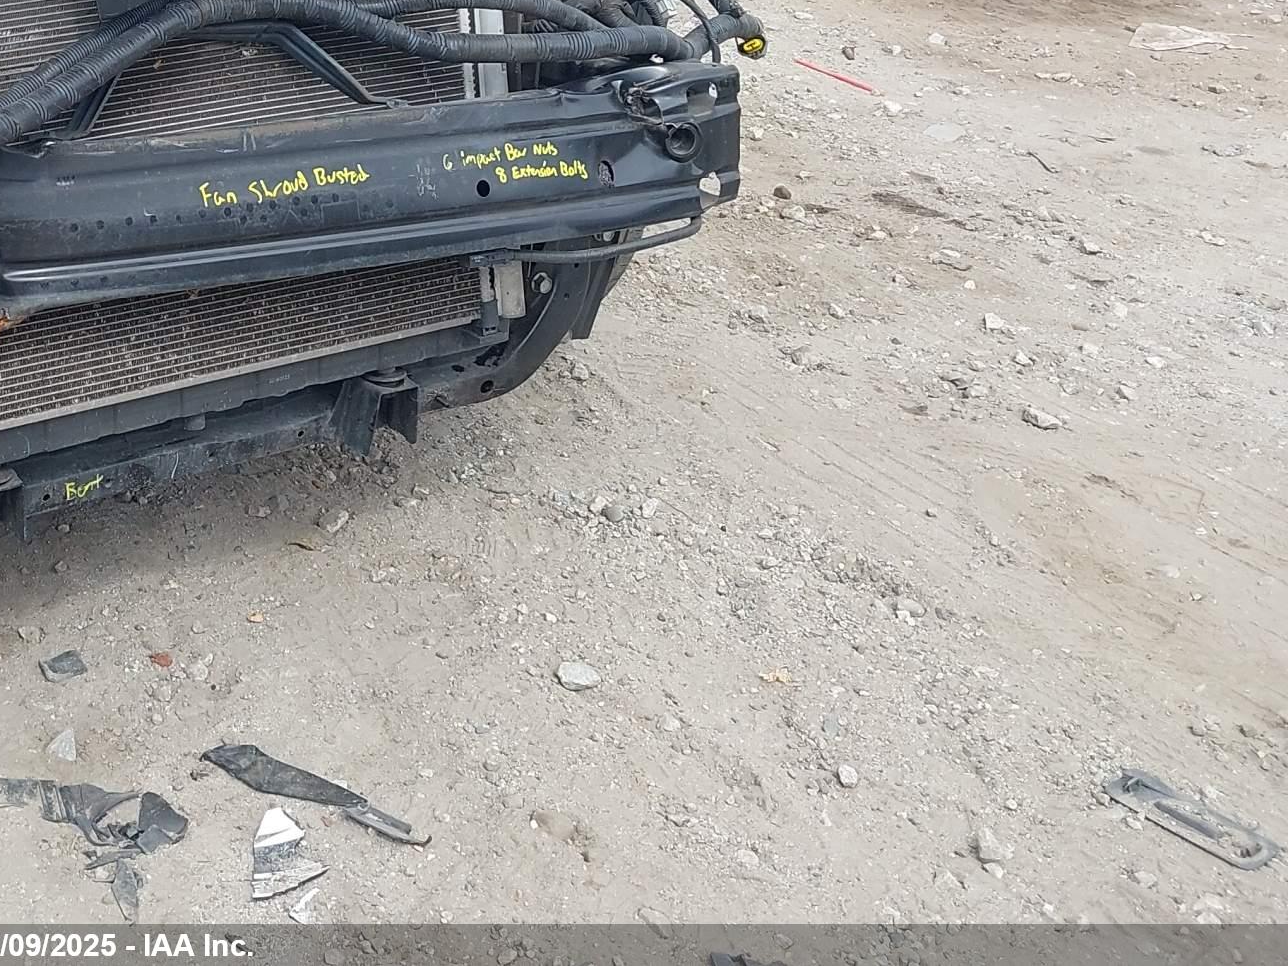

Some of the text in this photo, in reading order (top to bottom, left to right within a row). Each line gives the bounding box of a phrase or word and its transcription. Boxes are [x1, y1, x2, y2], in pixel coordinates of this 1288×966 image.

[198, 181, 238, 208] Fan
[312, 163, 371, 186] Busted
[495, 166, 508, 184] 8
